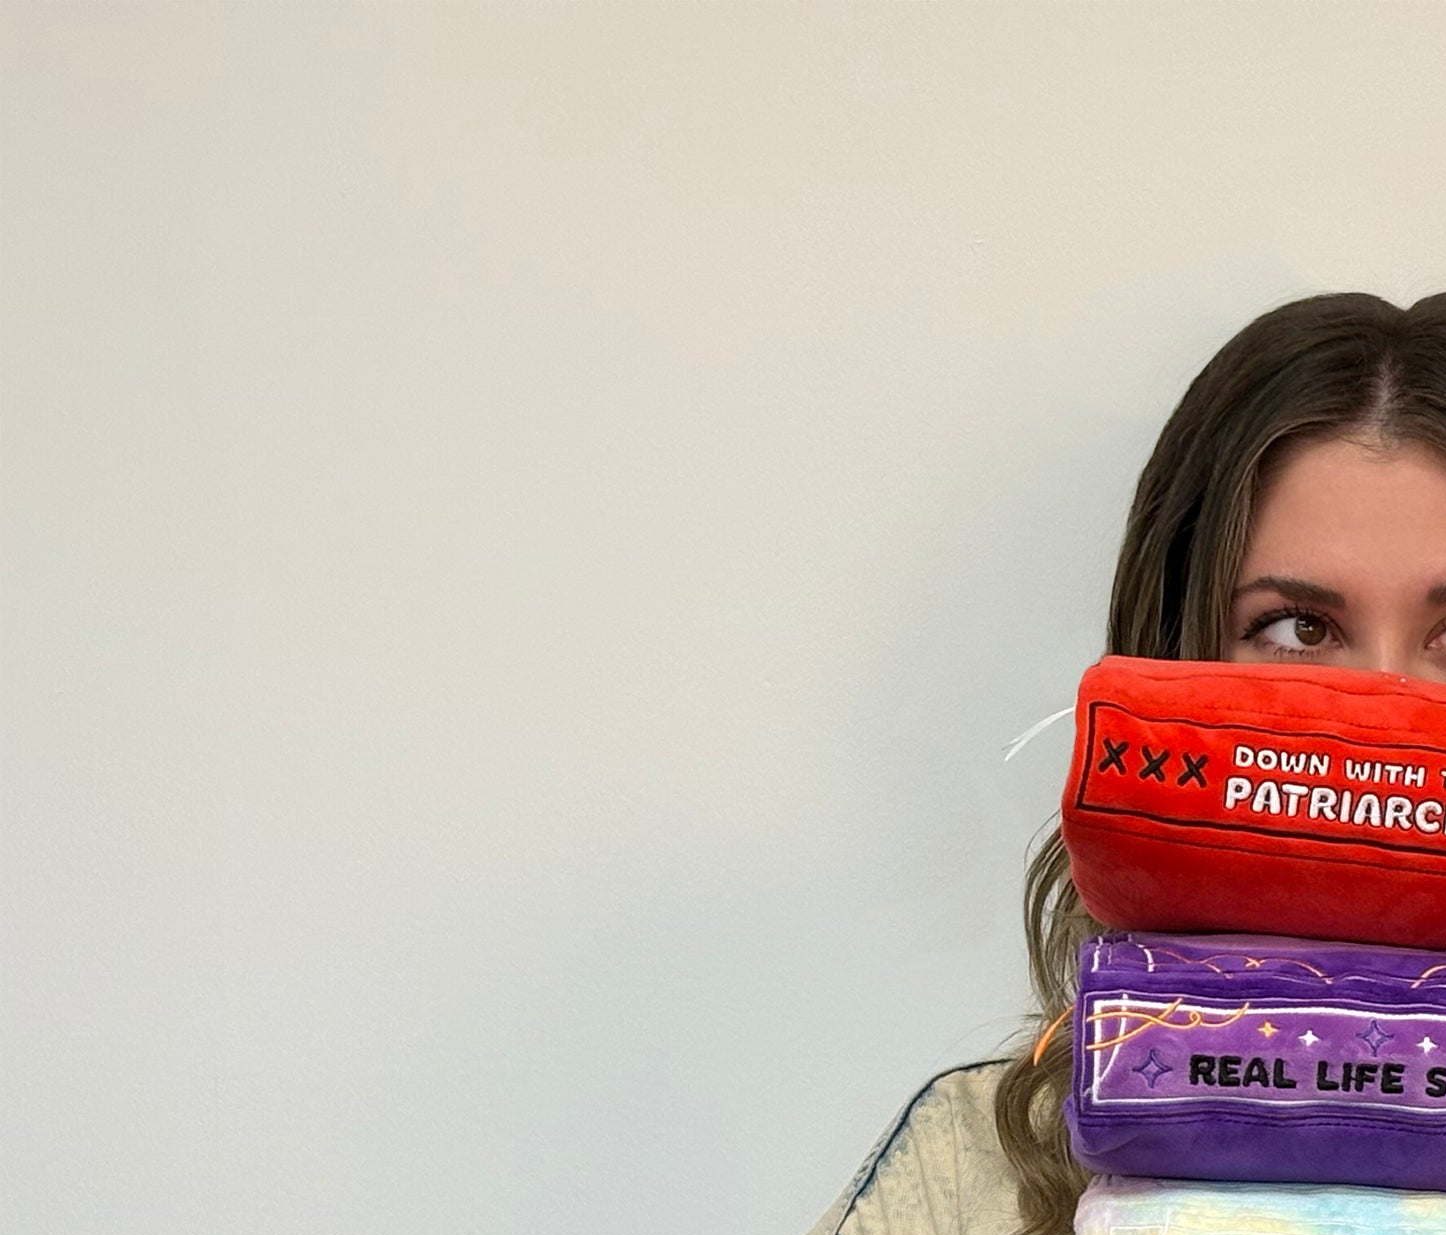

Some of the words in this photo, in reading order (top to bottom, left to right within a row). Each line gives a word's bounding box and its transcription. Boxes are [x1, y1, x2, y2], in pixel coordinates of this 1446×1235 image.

[1234, 745, 1330, 776] DOWN
[1345, 759, 1425, 787] WITH
[1189, 1054, 1297, 1089] REAL
[1316, 1060, 1406, 1094] LIFE
